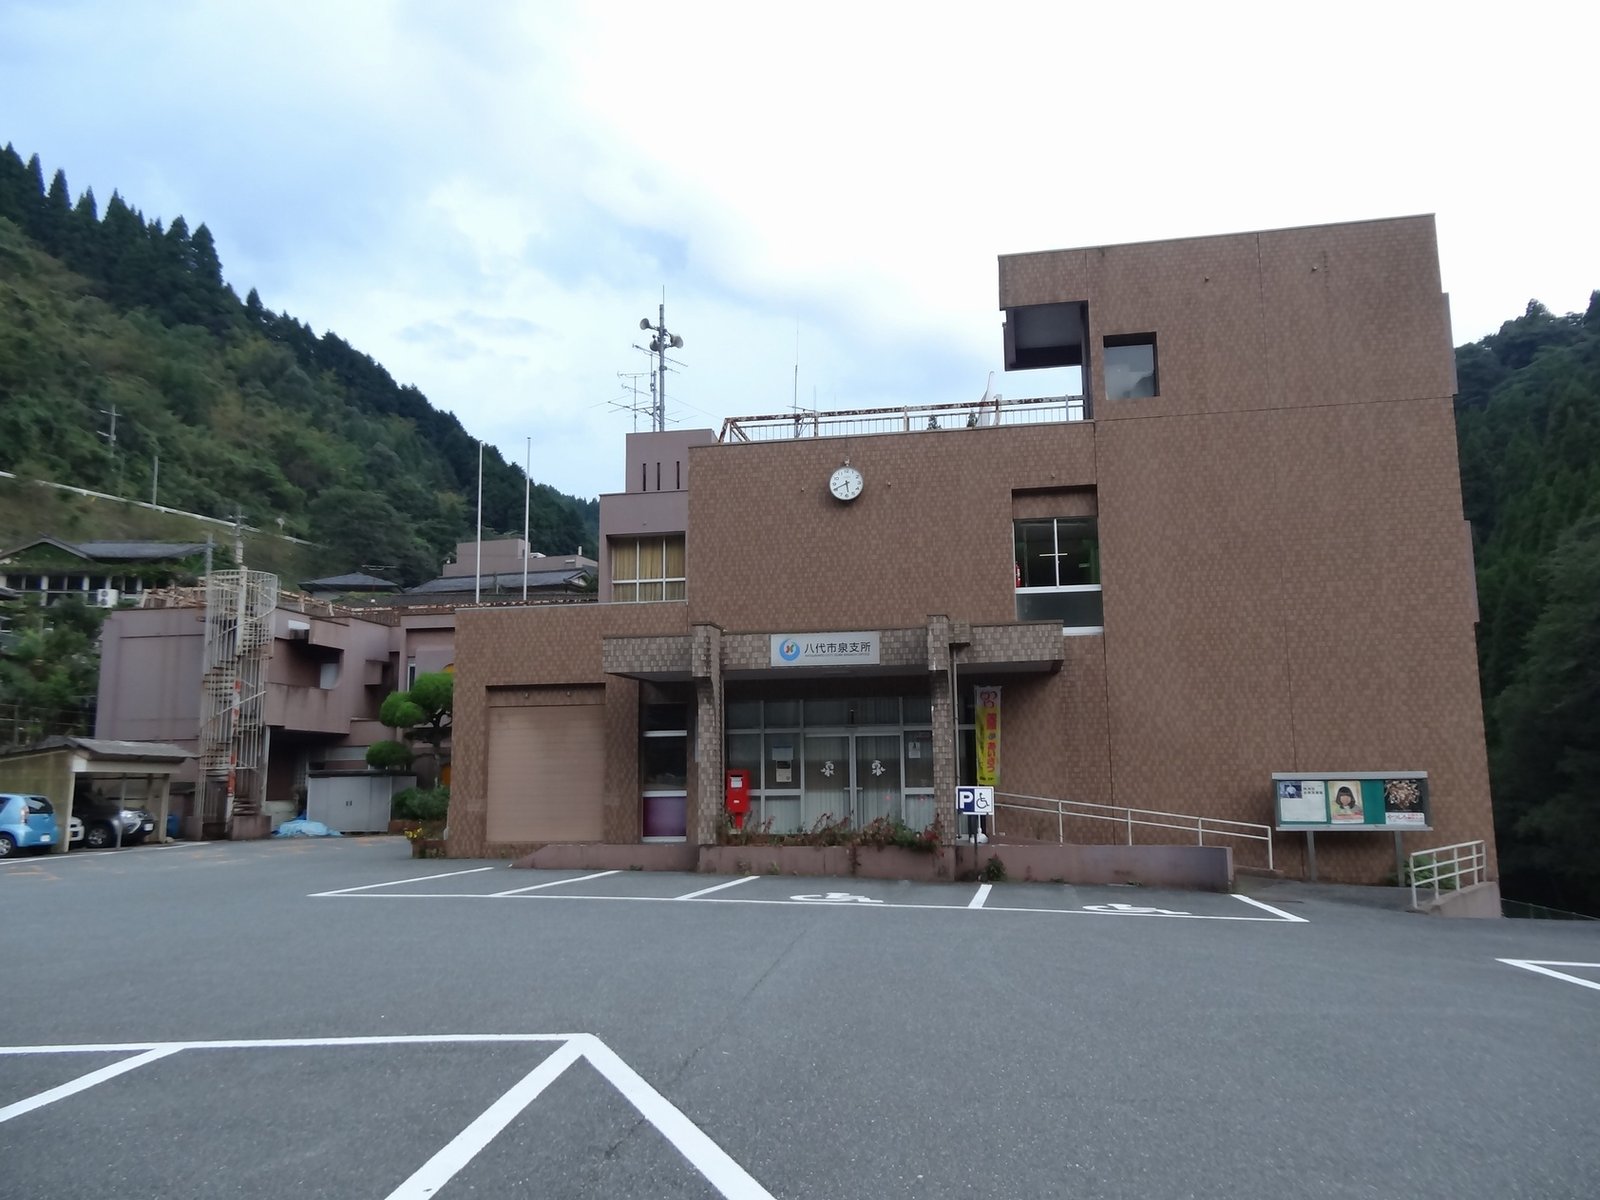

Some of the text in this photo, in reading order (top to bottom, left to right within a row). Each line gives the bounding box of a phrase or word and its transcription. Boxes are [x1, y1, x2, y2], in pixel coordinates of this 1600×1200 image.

[804, 641, 871, 654] 八代市泉支所
[960, 791, 974, 808] P
